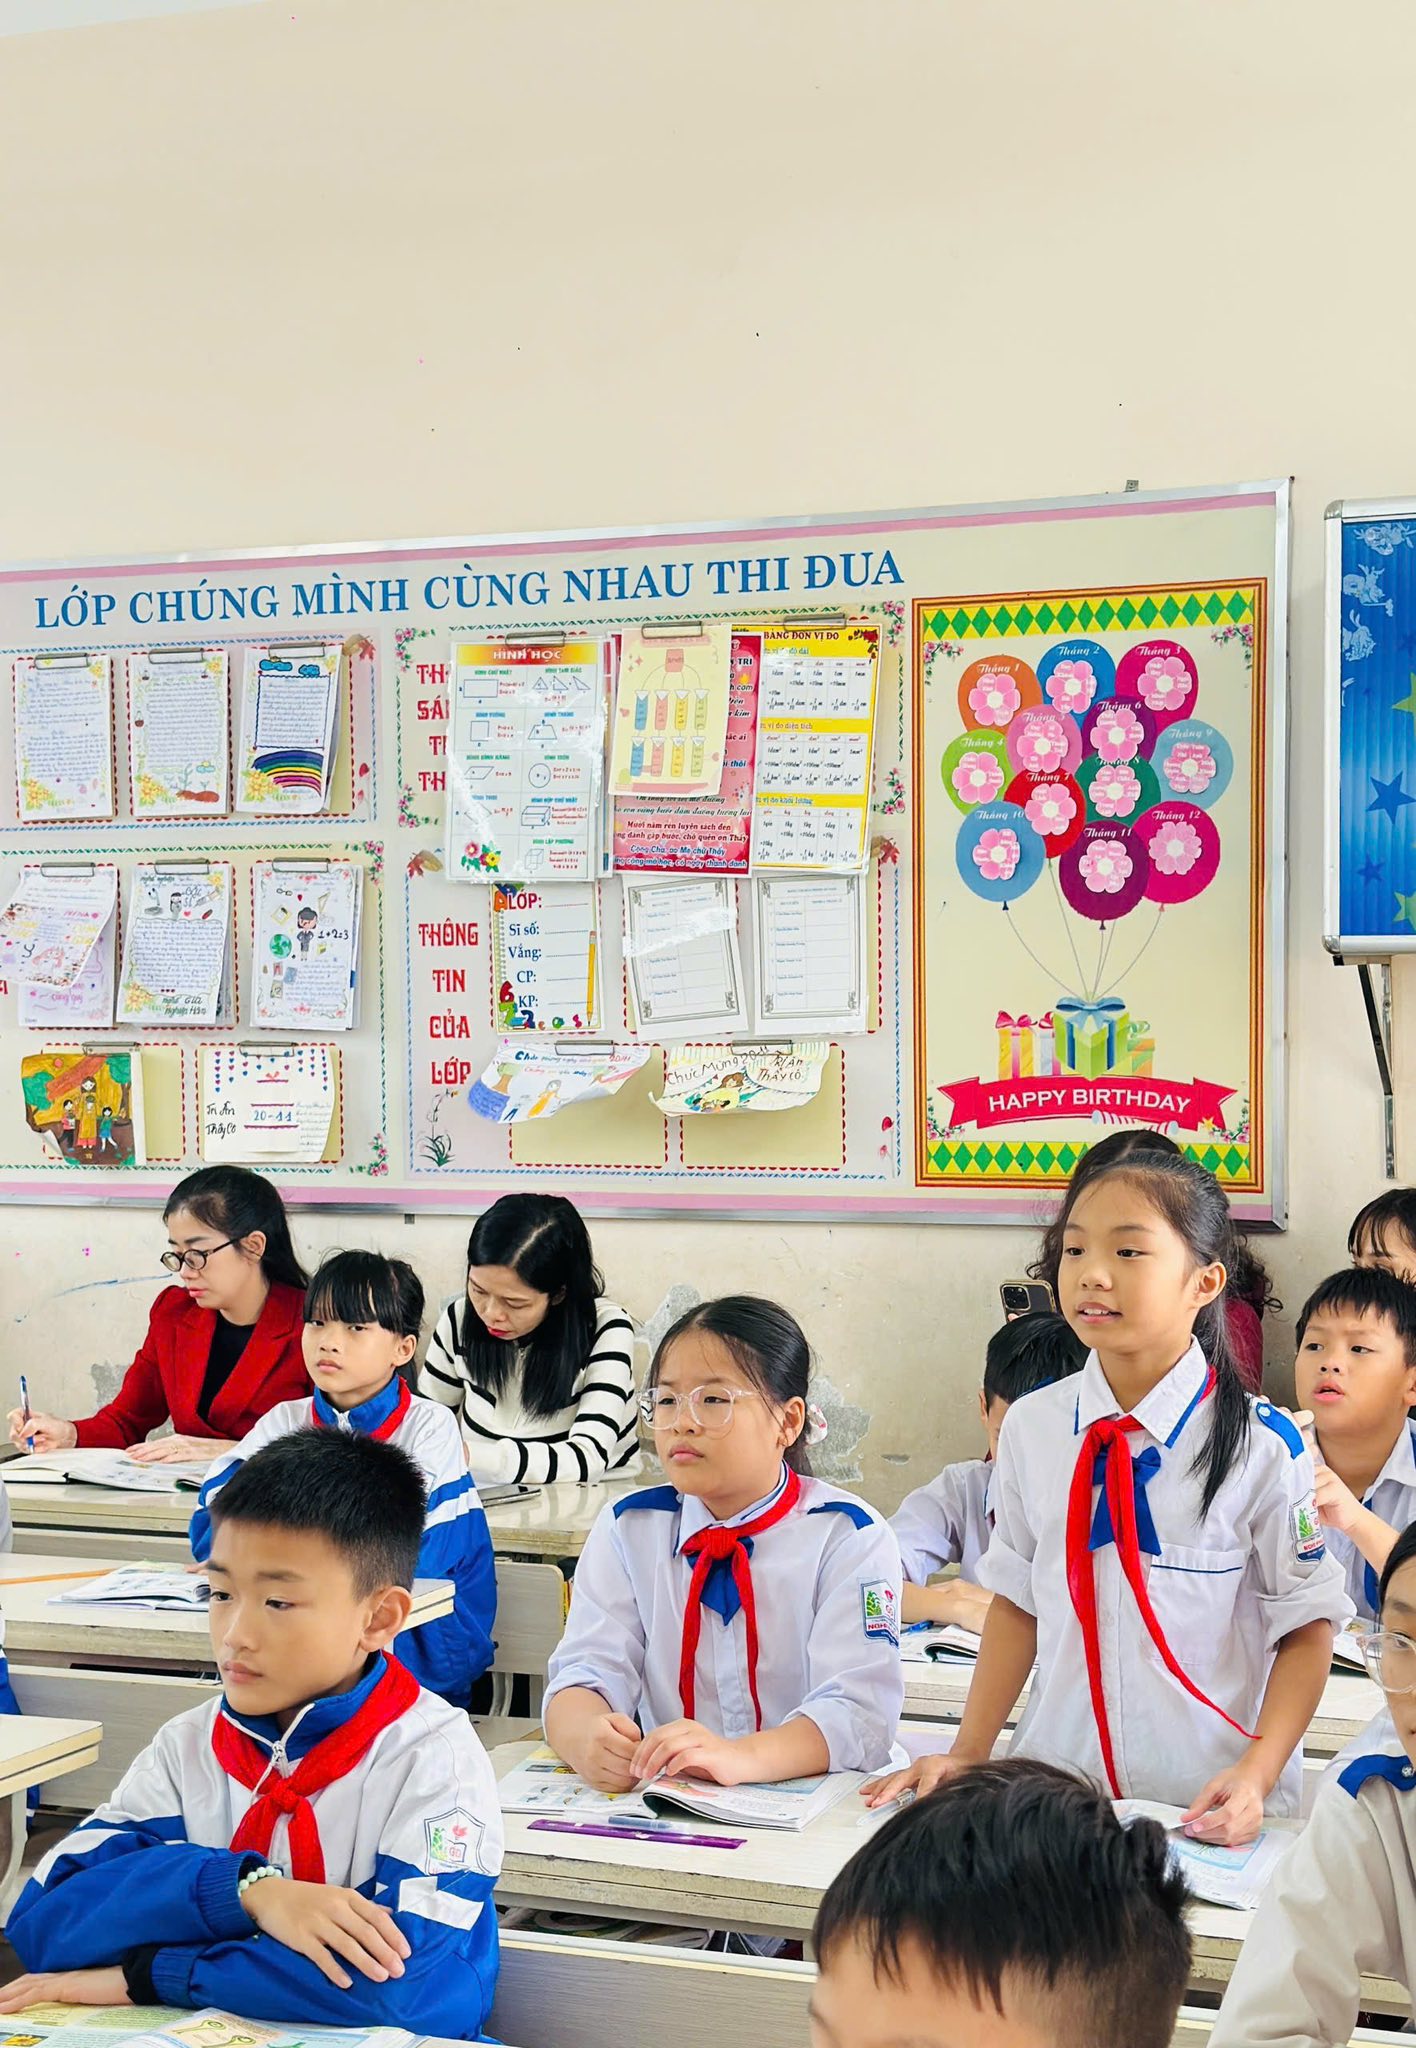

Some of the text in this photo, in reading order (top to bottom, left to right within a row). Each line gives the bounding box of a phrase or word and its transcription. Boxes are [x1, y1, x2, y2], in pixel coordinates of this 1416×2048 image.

[35, 549, 905, 629] LỚP CHÚNG MÌNH CÙNG NHAU THI ĐUA
[493, 647, 561, 663] HÌNH HỌC
[1056, 645, 1100, 656] Tháng 2
[1136, 645, 1181, 656] Tháng 3
[977, 664, 1020, 673] Tháng 1
[1098, 701, 1131, 711] Tháng
[1022, 712, 1056, 722] Tháng
[1169, 728, 1213, 738] Tháng 9
[959, 738, 994, 748] Tháng
[1025, 772, 1060, 782] Tháng
[975, 811, 1009, 821] Tháng
[1152, 811, 1201, 821] Tháng 12
[1084, 828, 1132, 838] Tháng 11
[508, 888, 542, 910] LỚP:
[418, 917, 479, 947] THÔNG
[523, 921, 540, 936] số:
[508, 943, 542, 962] Vắng:
[432, 969, 466, 993] TIN
[516, 969, 537, 983] CP:
[518, 994, 539, 1009] KP:
[429, 1008, 471, 1039] CỦA
[431, 1056, 472, 1085] LỚP
[988, 1088, 1191, 1114] HAPPY BIRTHDAY
